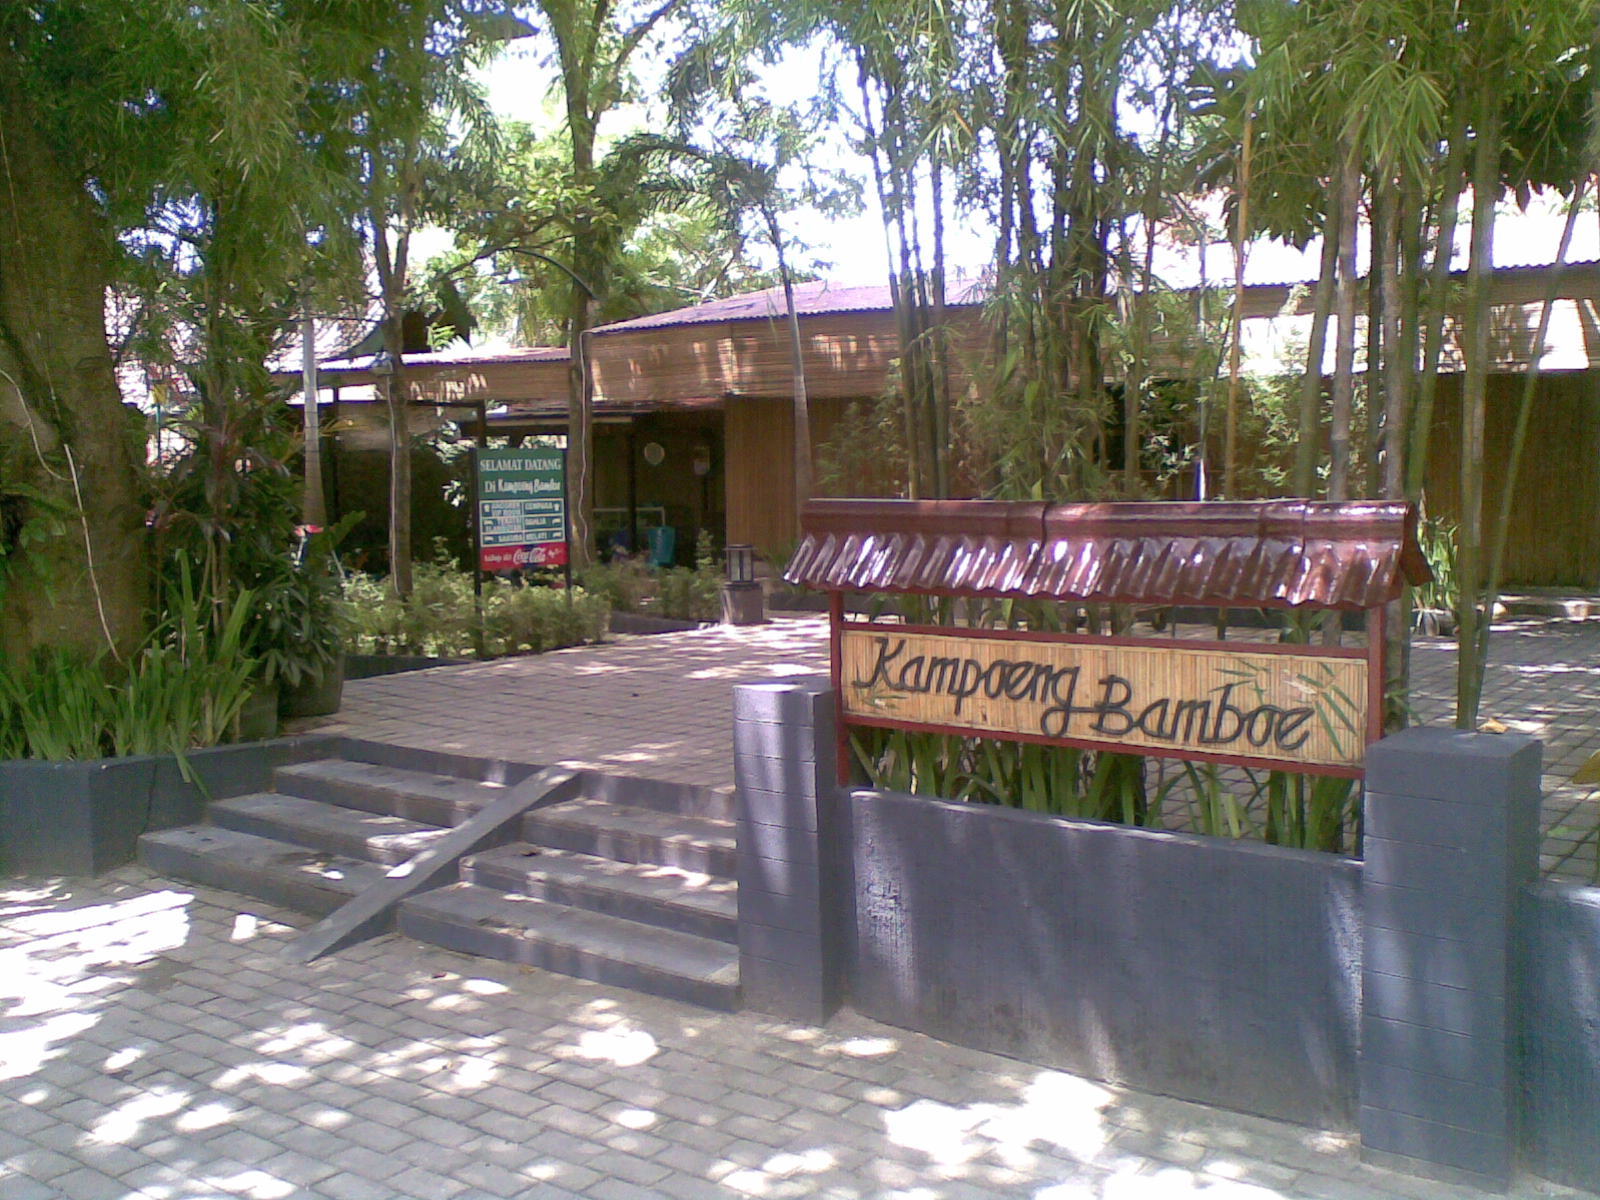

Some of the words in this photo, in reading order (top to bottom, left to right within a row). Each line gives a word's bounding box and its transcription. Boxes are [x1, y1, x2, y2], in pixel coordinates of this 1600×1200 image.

[480, 459, 522, 471] SELAMAT
[525, 458, 561, 471] DATANG
[484, 481, 496, 493] Di
[852, 637, 1082, 737] Kampoeng
[1090, 674, 1316, 750] Bamboe
